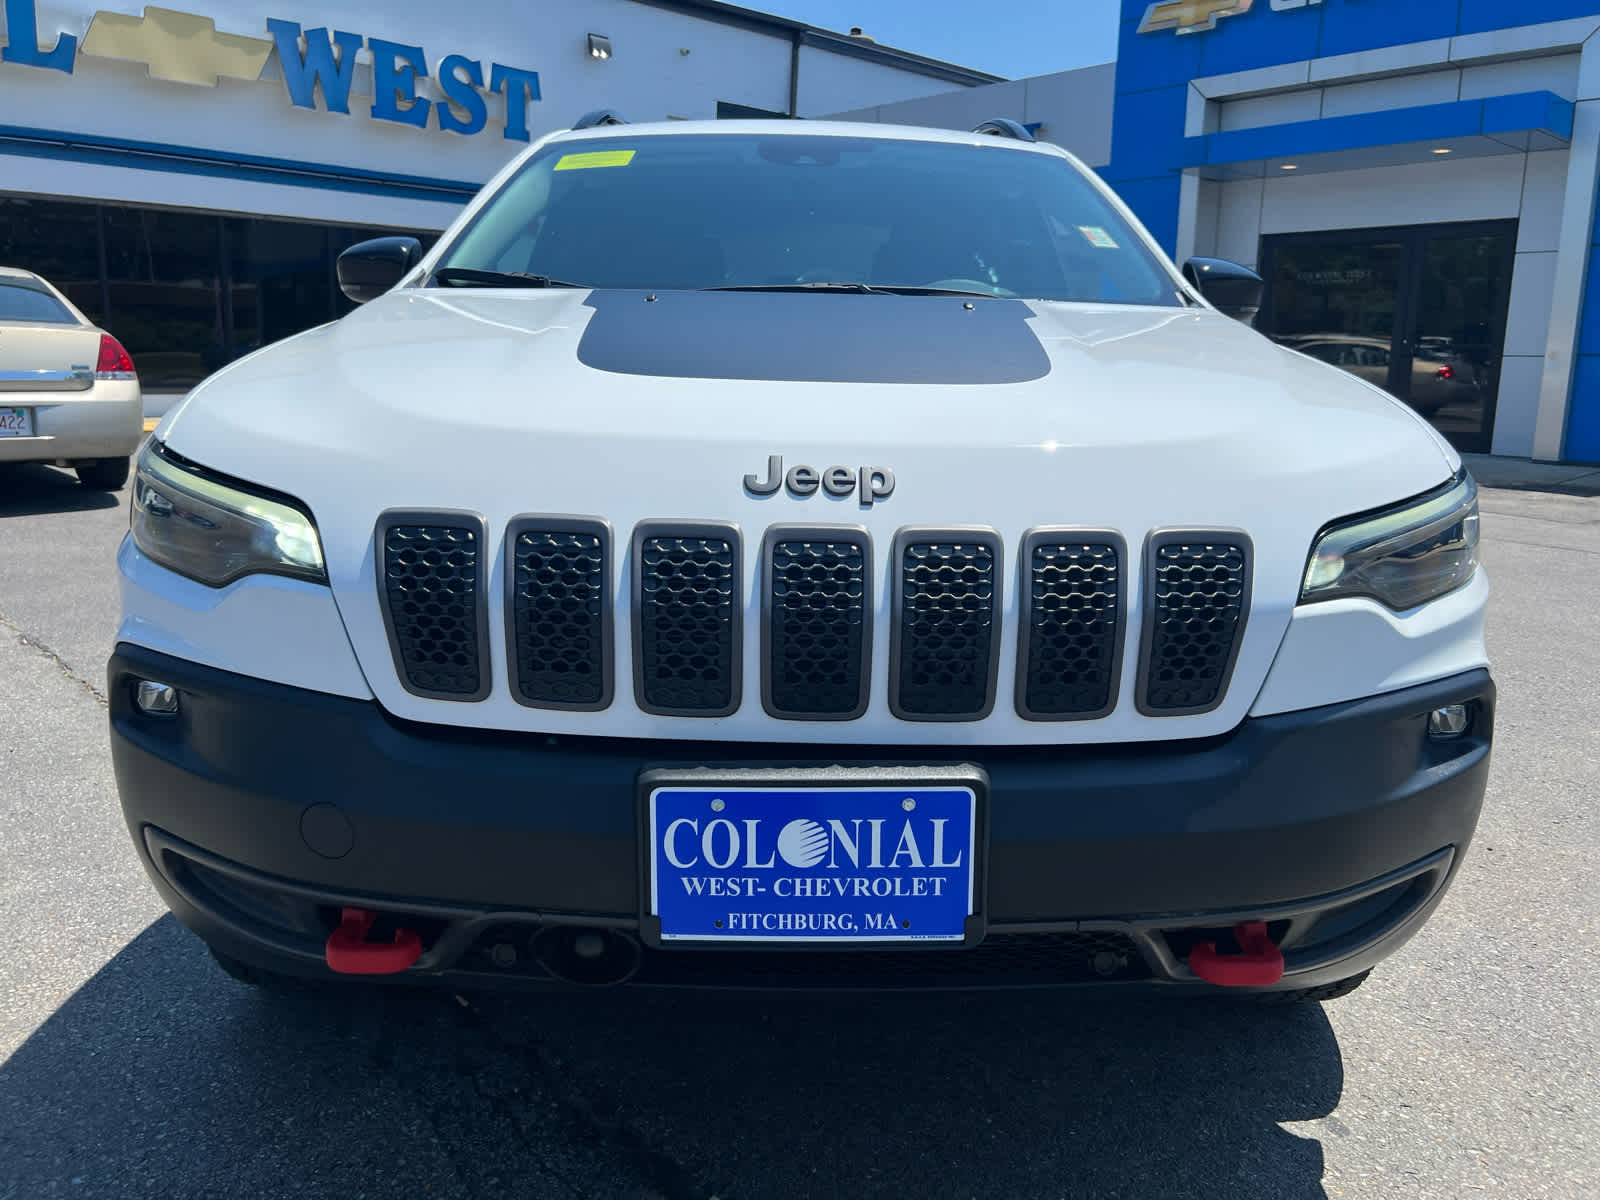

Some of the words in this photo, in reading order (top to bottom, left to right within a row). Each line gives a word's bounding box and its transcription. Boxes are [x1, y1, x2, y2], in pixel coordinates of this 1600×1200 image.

[266, 17, 542, 142] WEST
[743, 455, 896, 506] Jeep
[664, 818, 962, 869] COLONIAL
[680, 877, 766, 897] WEST-
[773, 877, 947, 897] CHEVROLET
[728, 913, 859, 932] FITCHBURG,
[864, 913, 898, 930] MA
